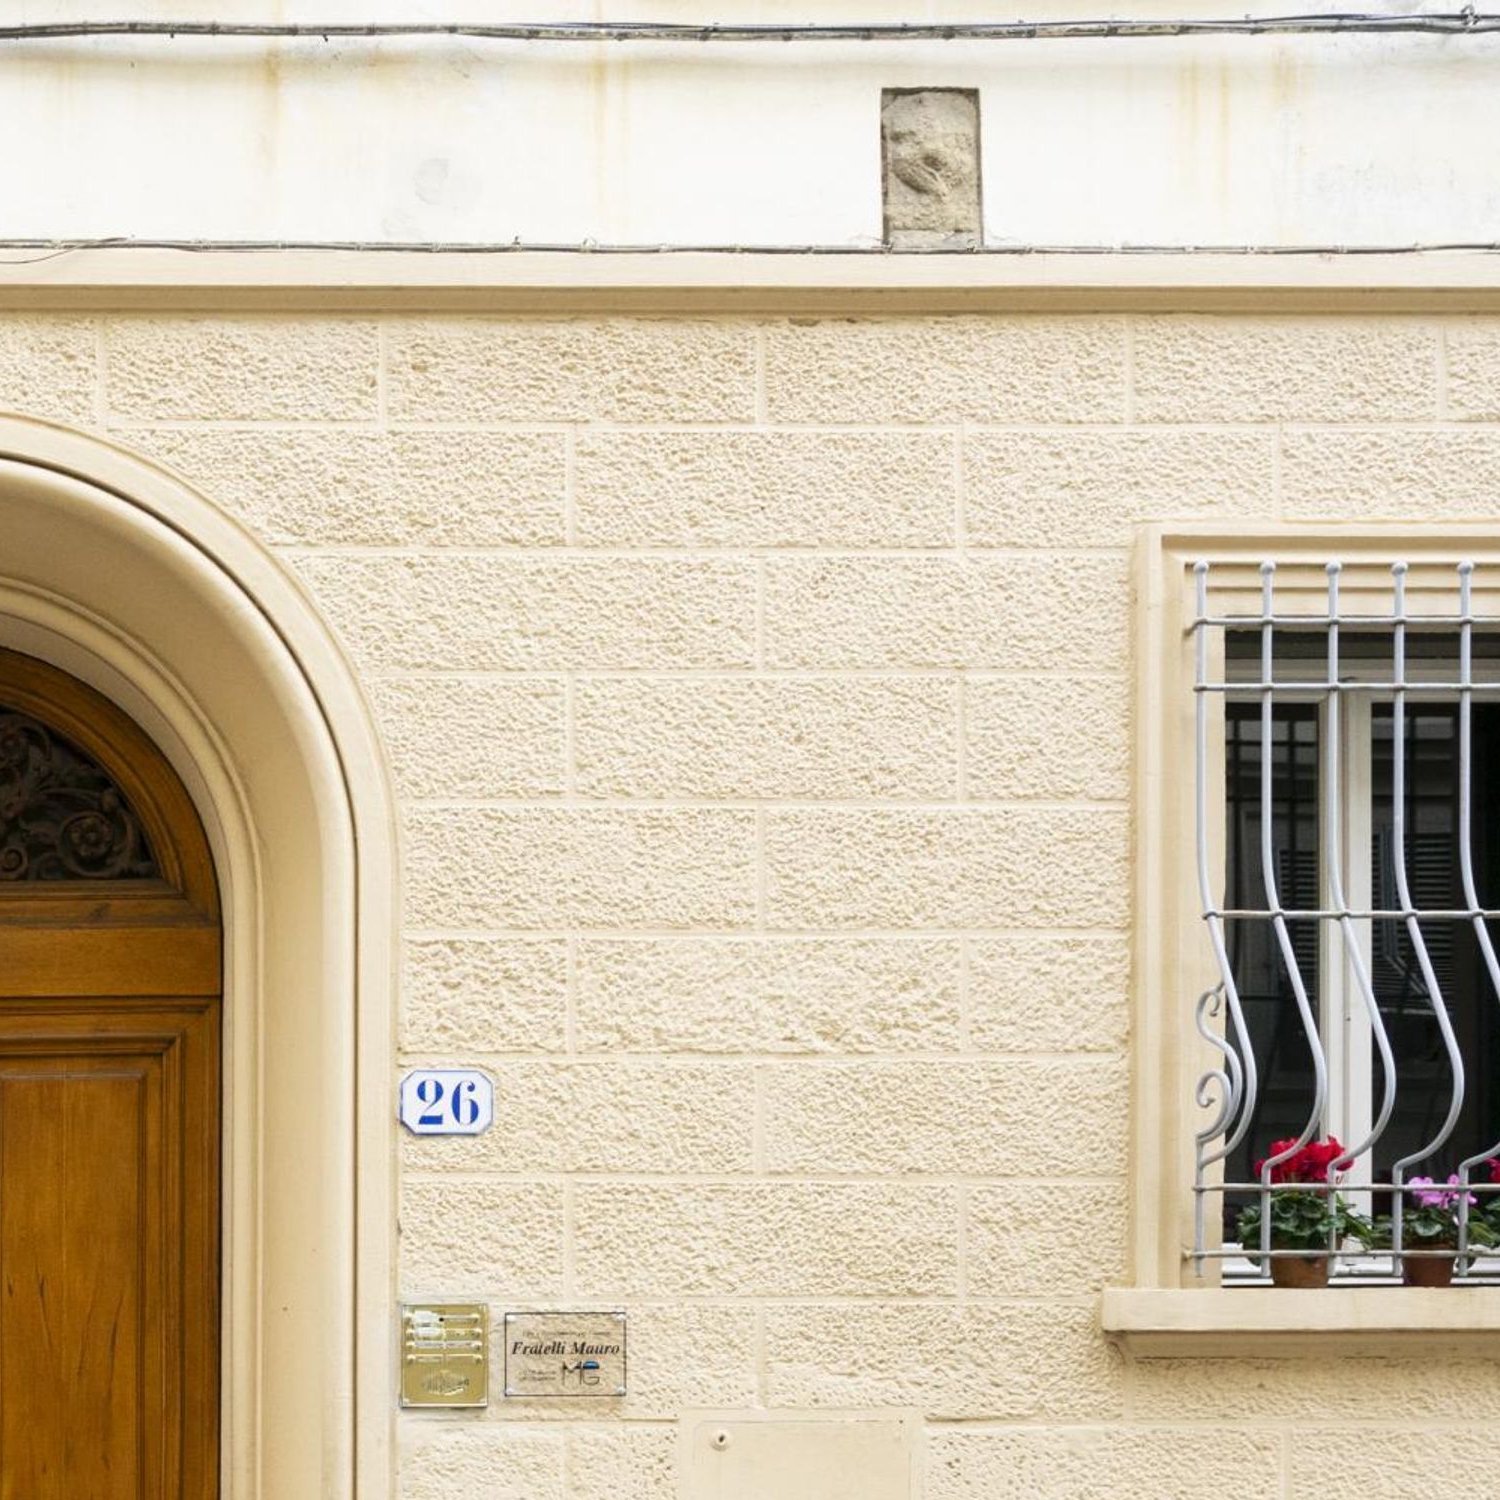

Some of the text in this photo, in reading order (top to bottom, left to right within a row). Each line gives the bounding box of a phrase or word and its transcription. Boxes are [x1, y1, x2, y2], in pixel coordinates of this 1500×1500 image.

[417, 1079, 479, 1125] 26
[512, 1340, 620, 1355] Fratelli Mauro
